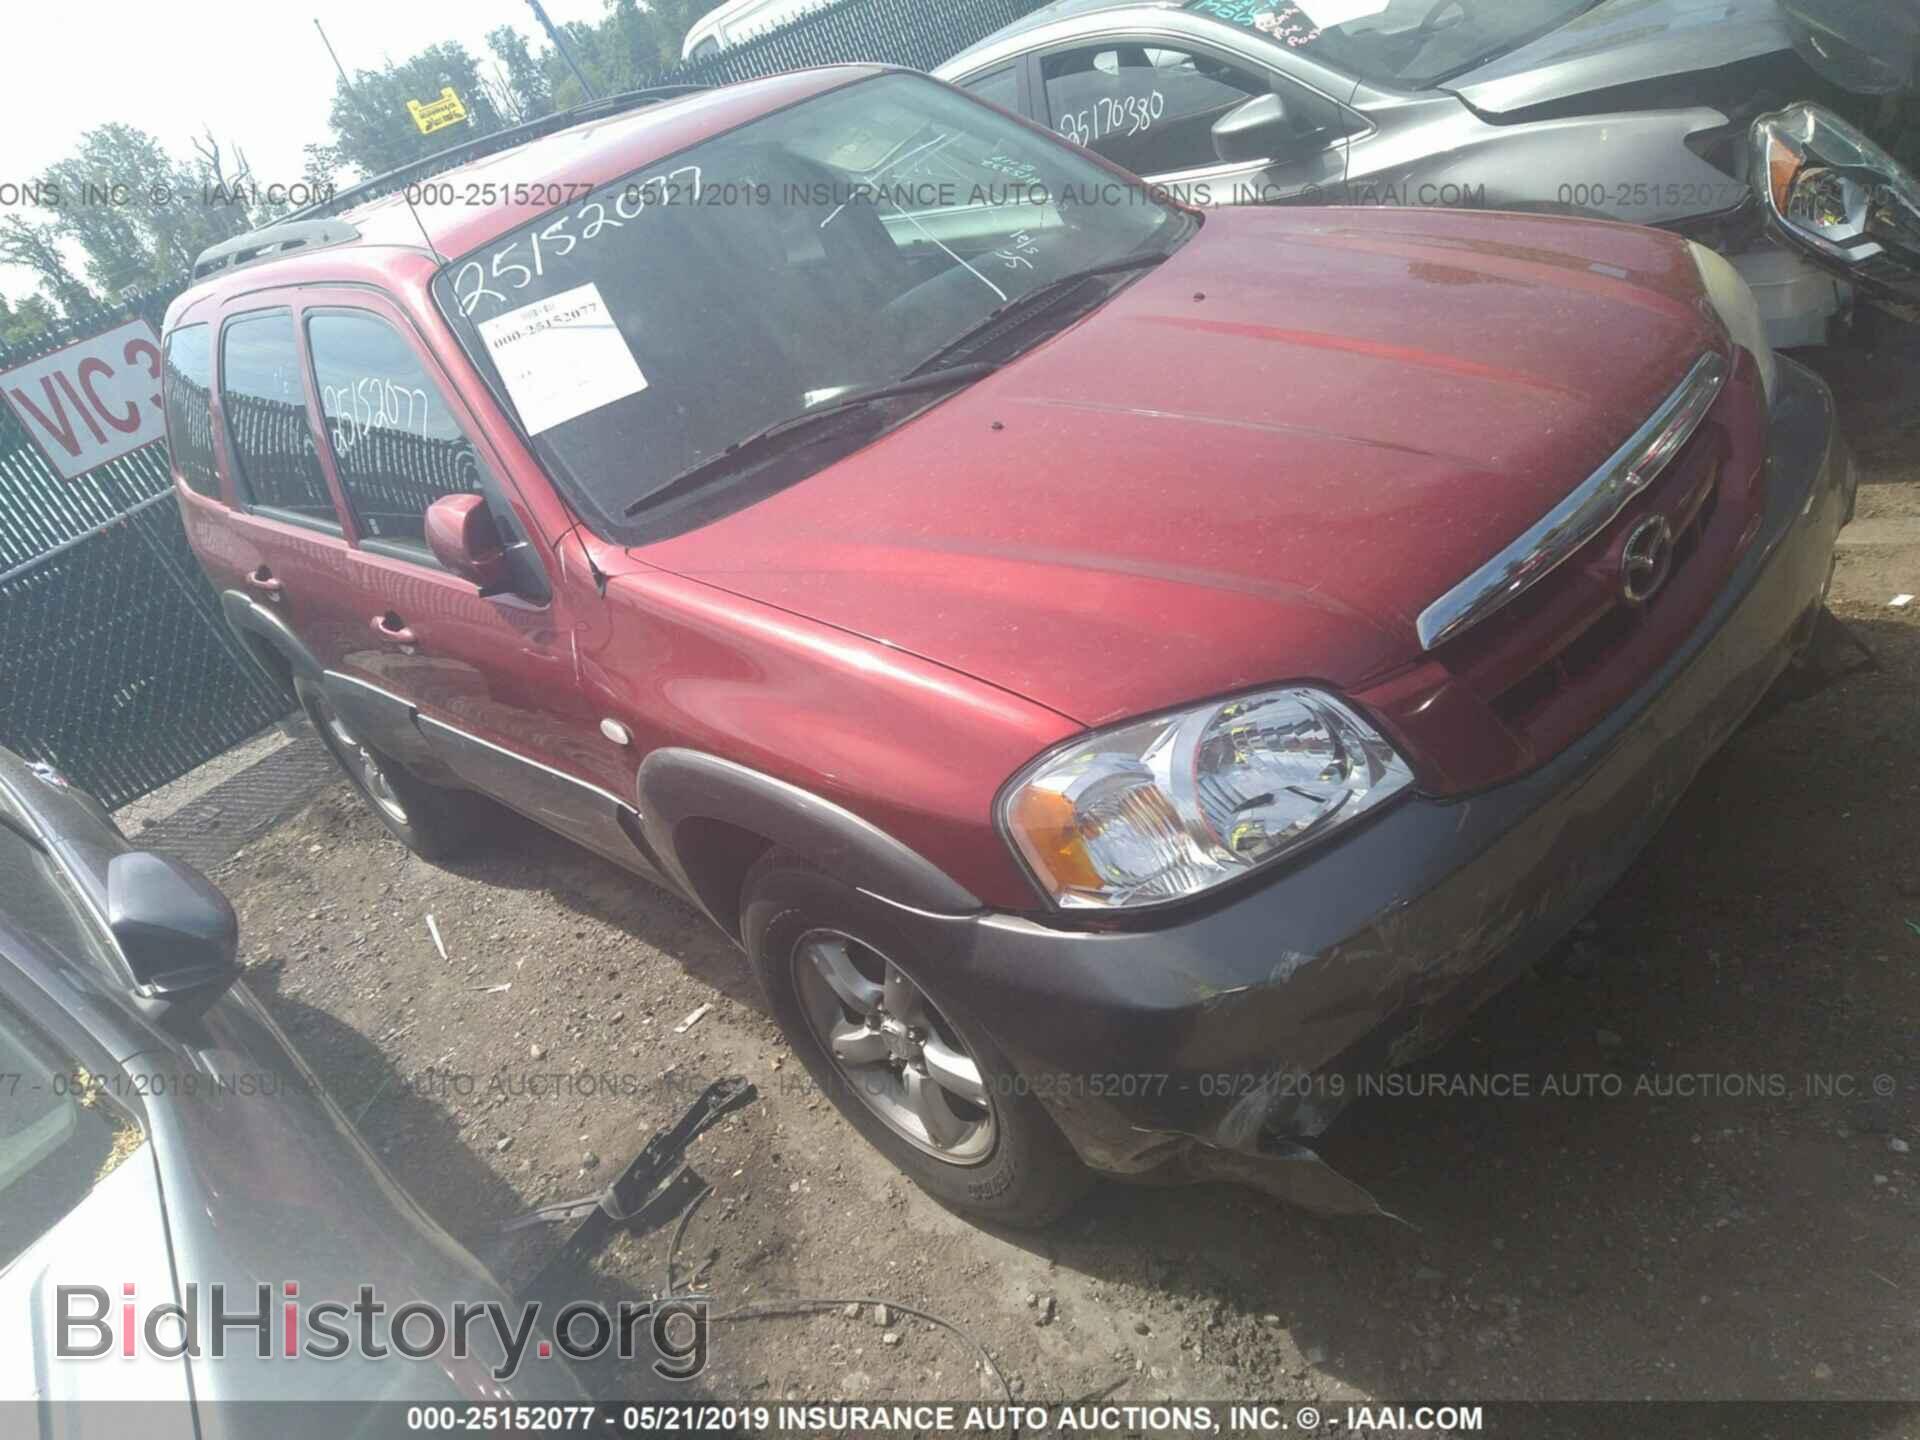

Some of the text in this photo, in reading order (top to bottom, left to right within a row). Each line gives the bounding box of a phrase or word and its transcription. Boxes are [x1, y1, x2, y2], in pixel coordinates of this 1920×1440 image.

[1060, 88, 1163, 148] 25170380
[453, 165, 702, 317] 25152077
[493, 302, 598, 349] 000-25152077
[10, 357, 141, 457] VIC
[323, 377, 428, 458] 25152077
